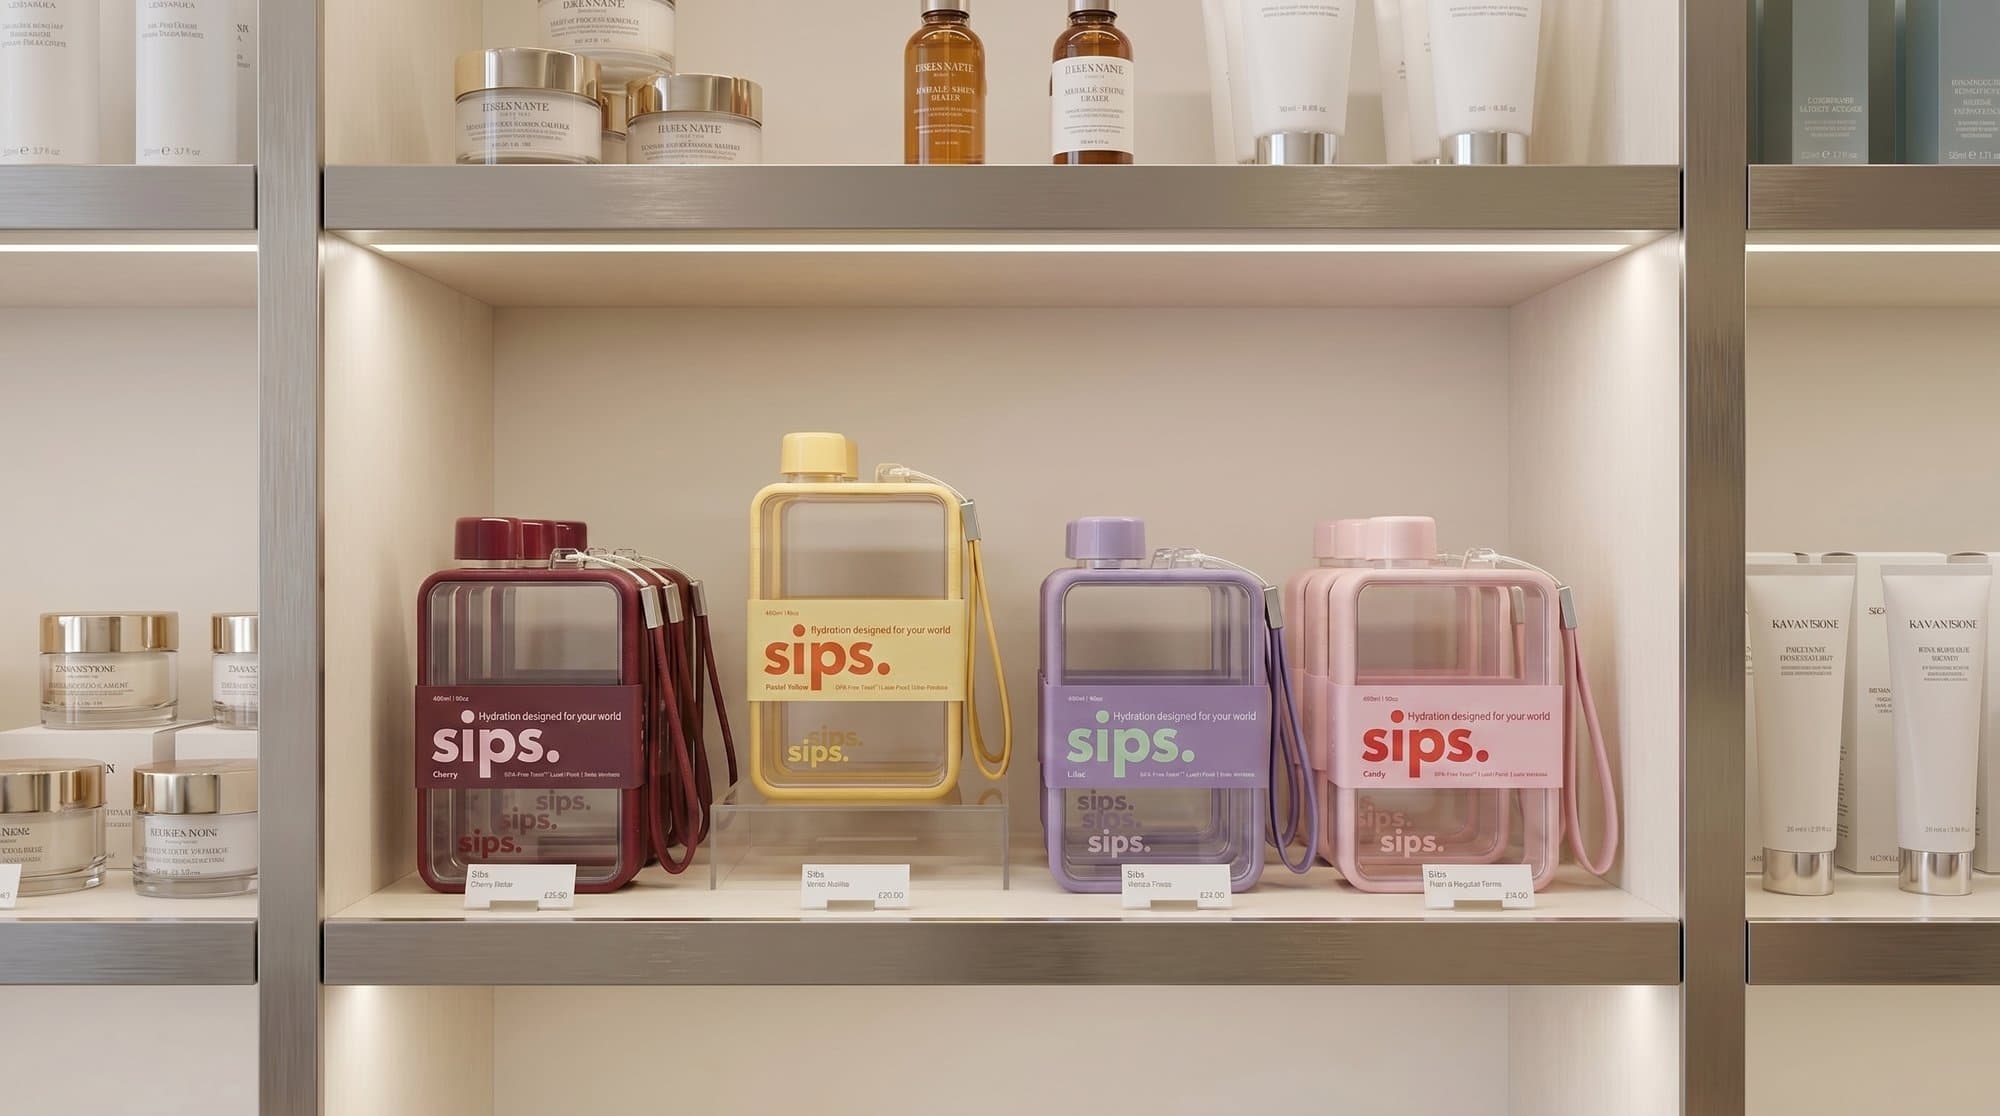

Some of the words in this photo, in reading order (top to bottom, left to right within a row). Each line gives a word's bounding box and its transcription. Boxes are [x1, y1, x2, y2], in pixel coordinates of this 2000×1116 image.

[852, 625, 892, 637] designed
[892, 625, 905, 635] for
[906, 628, 926, 637] your
[927, 625, 951, 635] world
[764, 623, 891, 691] sips.
[478, 711, 521, 723] Hydration
[522, 711, 562, 723] designed
[563, 711, 576, 721] for
[576, 714, 597, 723] your
[597, 711, 622, 721] world
[1113, 711, 1156, 723] Hydration
[1156, 711, 1197, 723] designed
[1198, 711, 1211, 721] for
[1211, 714, 1231, 723] your
[1232, 711, 1257, 721] world
[1407, 711, 1450, 723] Hydration
[1451, 711, 1491, 723] designed
[1492, 711, 1505, 721] for
[1505, 714, 1526, 723] your
[1526, 711, 1551, 721] world
[431, 709, 560, 779] sips.
[787, 738, 850, 769] sips.
[1066, 709, 1195, 778] sips.
[1362, 709, 1489, 779] sips.
[432, 770, 458, 780] Cherry
[1067, 771, 1086, 779] Lilac
[1362, 770, 1386, 780] Candy
[535, 789, 592, 816] sips.
[1077, 790, 1135, 817] sips.
[501, 806, 558, 836] sips.
[458, 828, 523, 860] sips.
[1087, 828, 1152, 859] sips.
[1380, 828, 1445, 859] sips.
